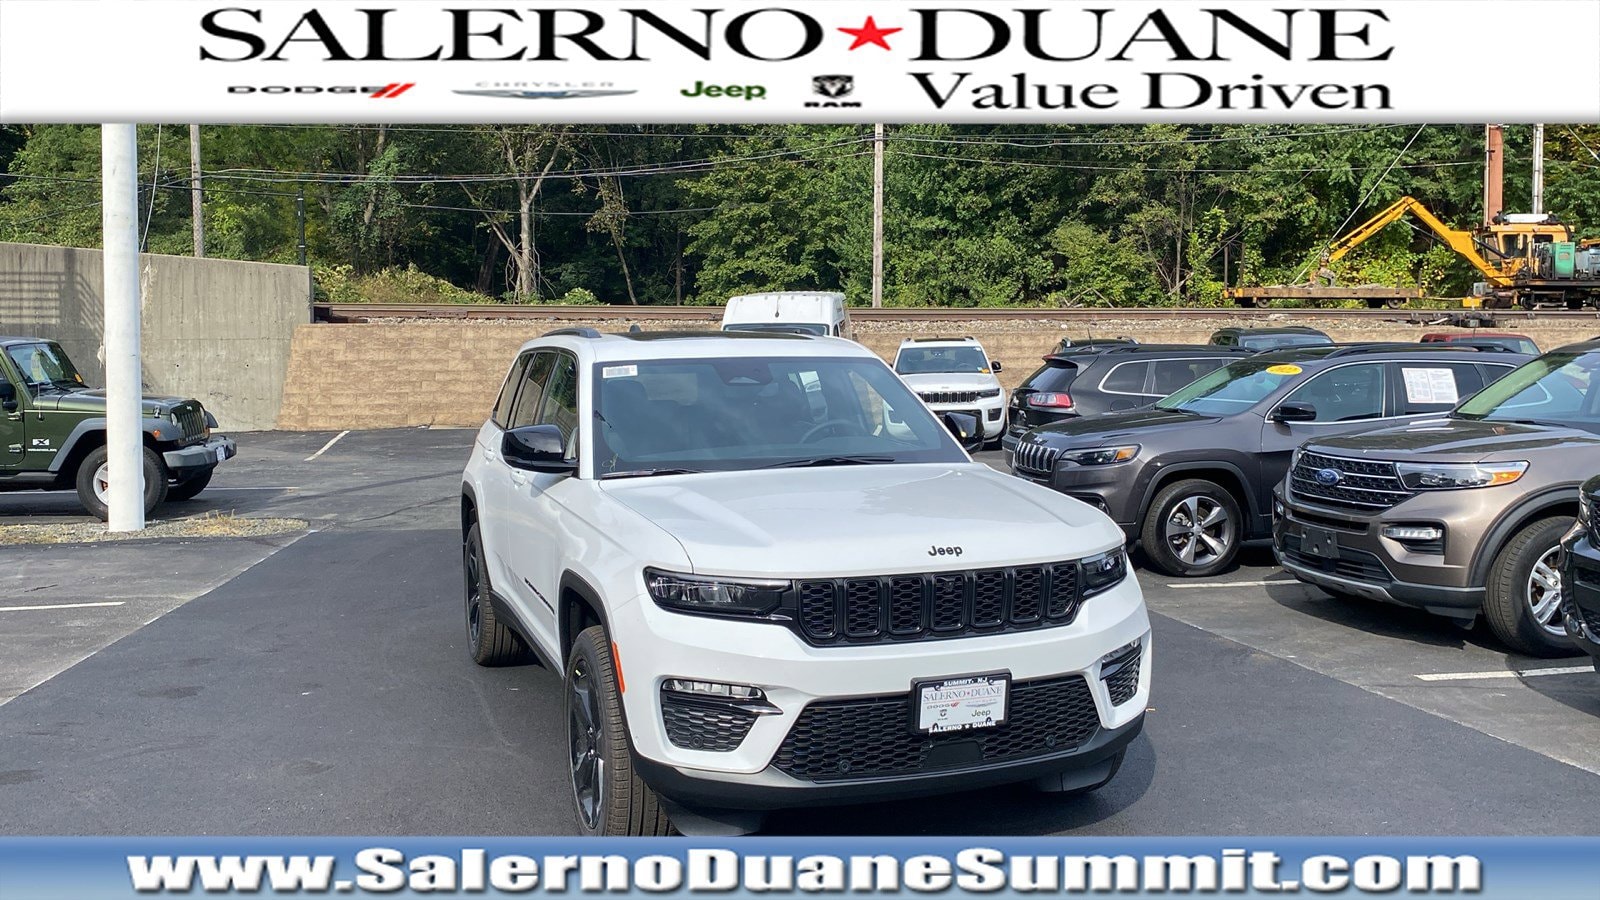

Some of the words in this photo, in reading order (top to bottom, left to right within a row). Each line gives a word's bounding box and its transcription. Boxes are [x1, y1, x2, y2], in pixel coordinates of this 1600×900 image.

[928, 545, 963, 557] Jeep
[923, 688, 966, 701] SALERNO
[971, 685, 1003, 697] DUANE
[971, 709, 991, 717] Jeep
